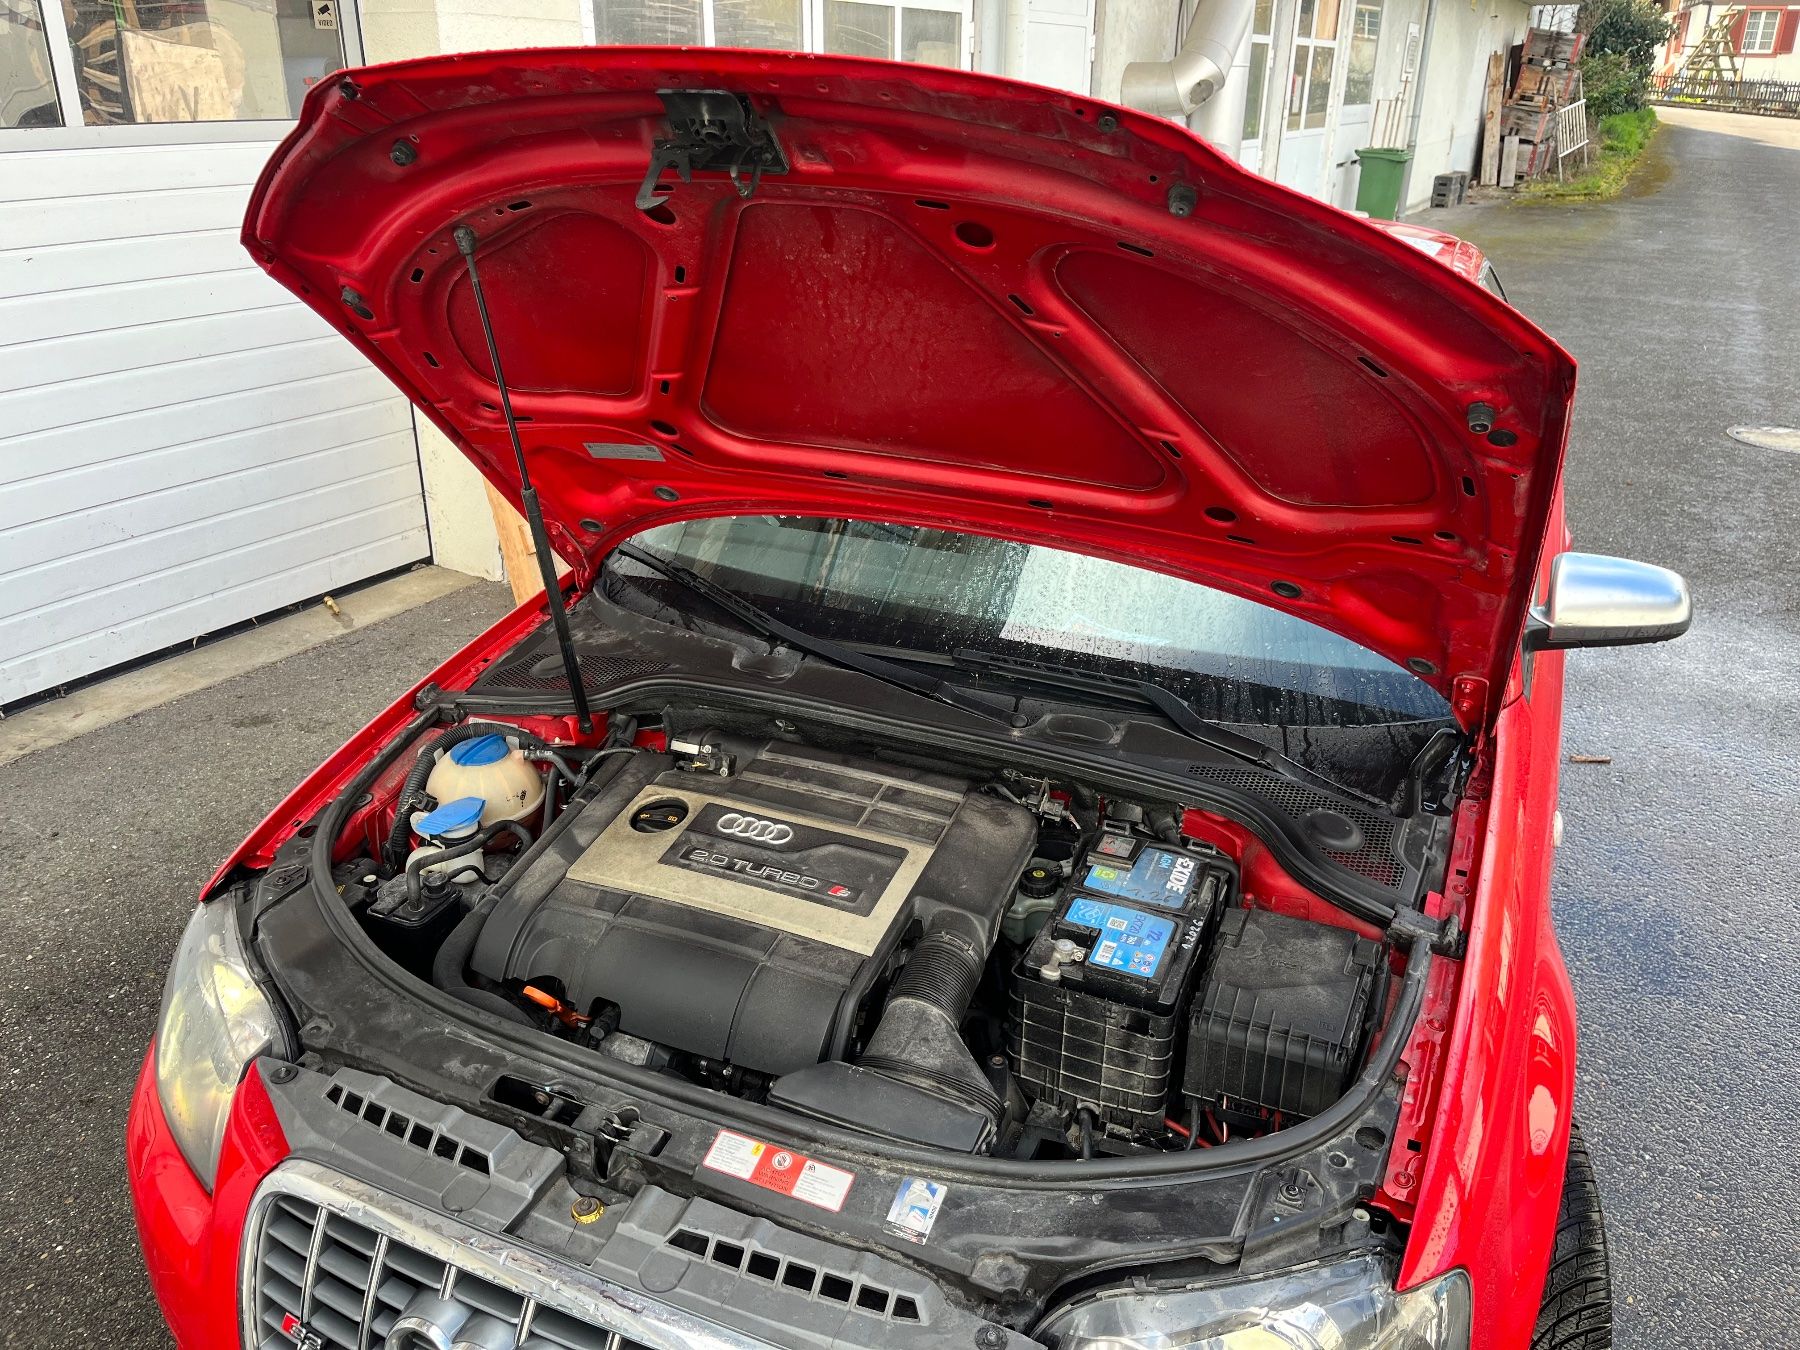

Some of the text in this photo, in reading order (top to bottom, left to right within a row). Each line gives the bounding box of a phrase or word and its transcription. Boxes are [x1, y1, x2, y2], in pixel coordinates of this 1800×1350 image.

[317, 19, 333, 27] VIDEO
[689, 850, 728, 868] 2.0
[733, 858, 821, 889] TURBO
[1158, 853, 1173, 869] AGM
[1166, 857, 1195, 895] EXIDE
